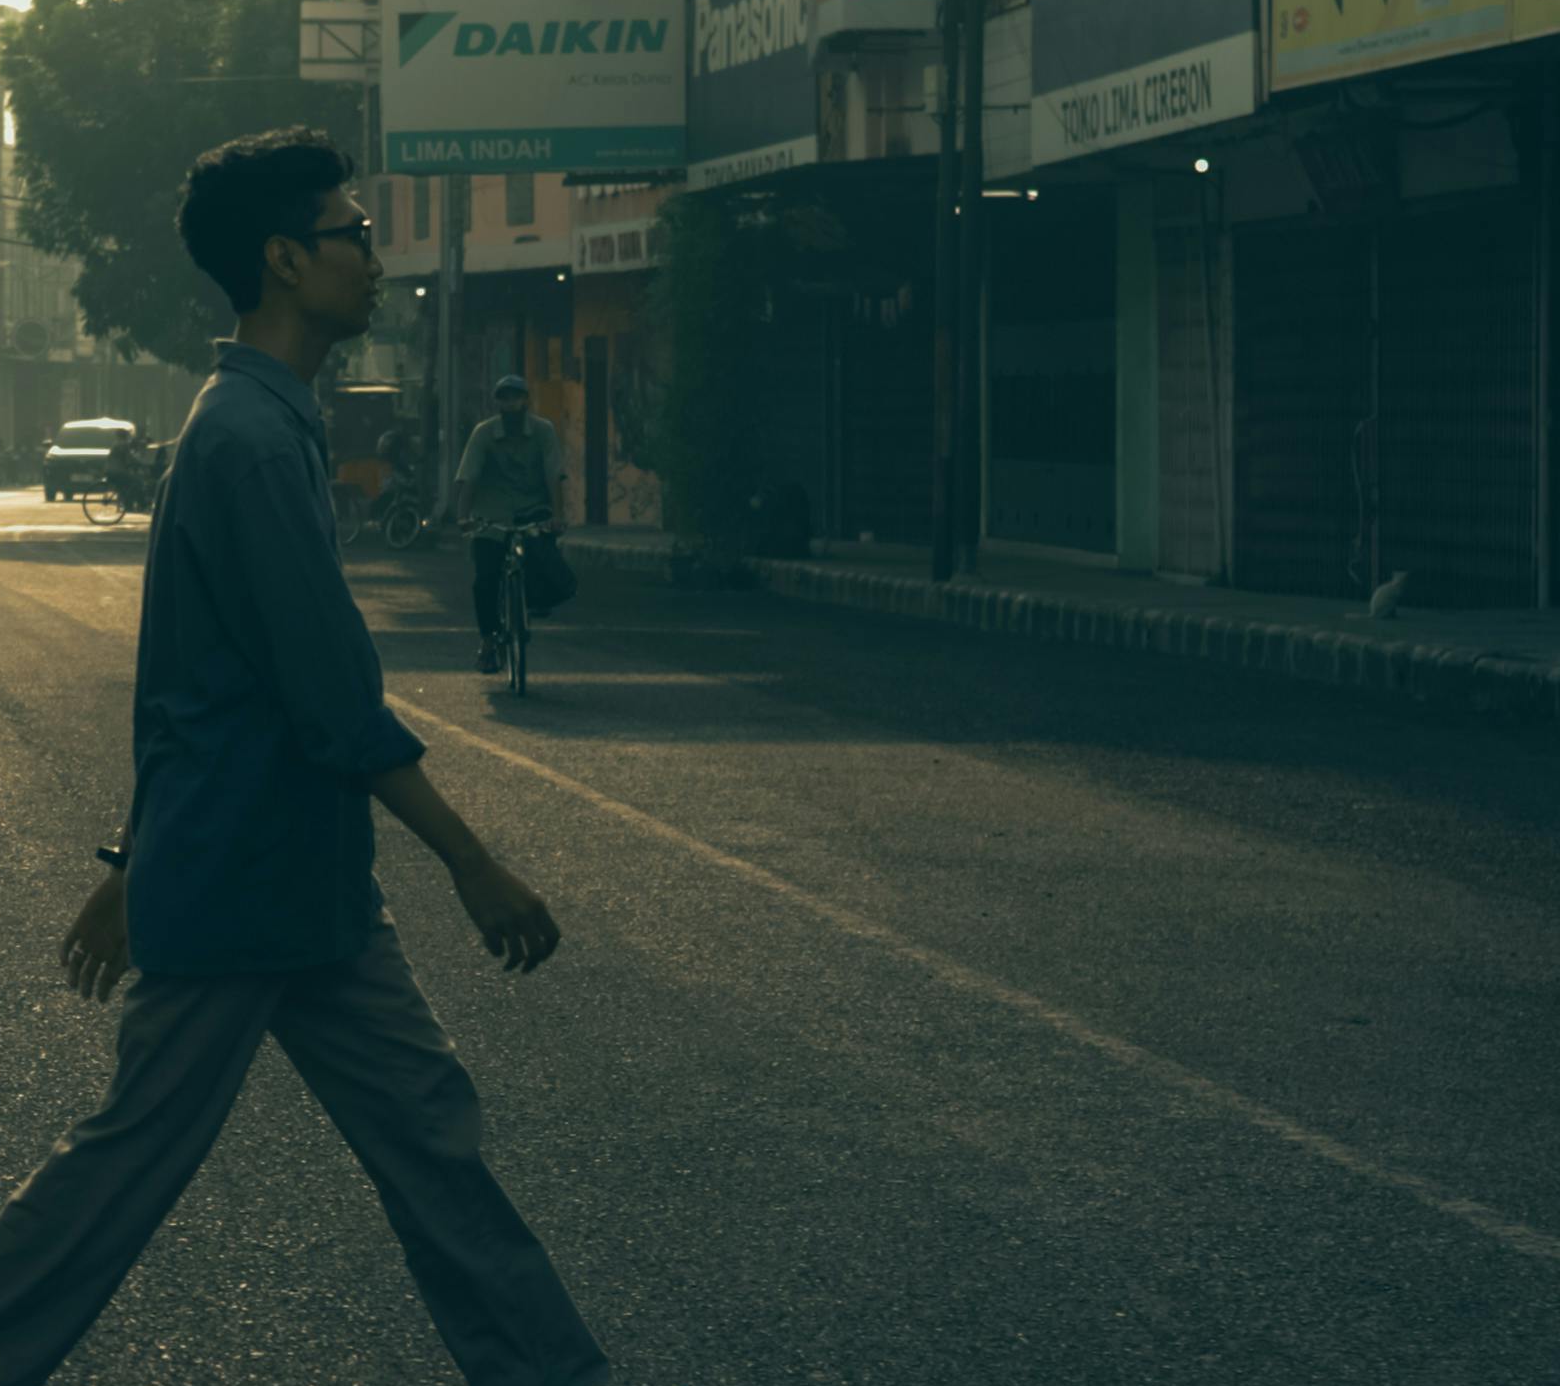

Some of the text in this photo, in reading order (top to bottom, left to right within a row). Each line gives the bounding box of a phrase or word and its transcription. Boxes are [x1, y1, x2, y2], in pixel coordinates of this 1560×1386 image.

[453, 18, 669, 58] DAIKIN
[1061, 58, 1213, 146] TOKO LIMA CIREBON
[401, 138, 552, 164] LIMA INDAH
